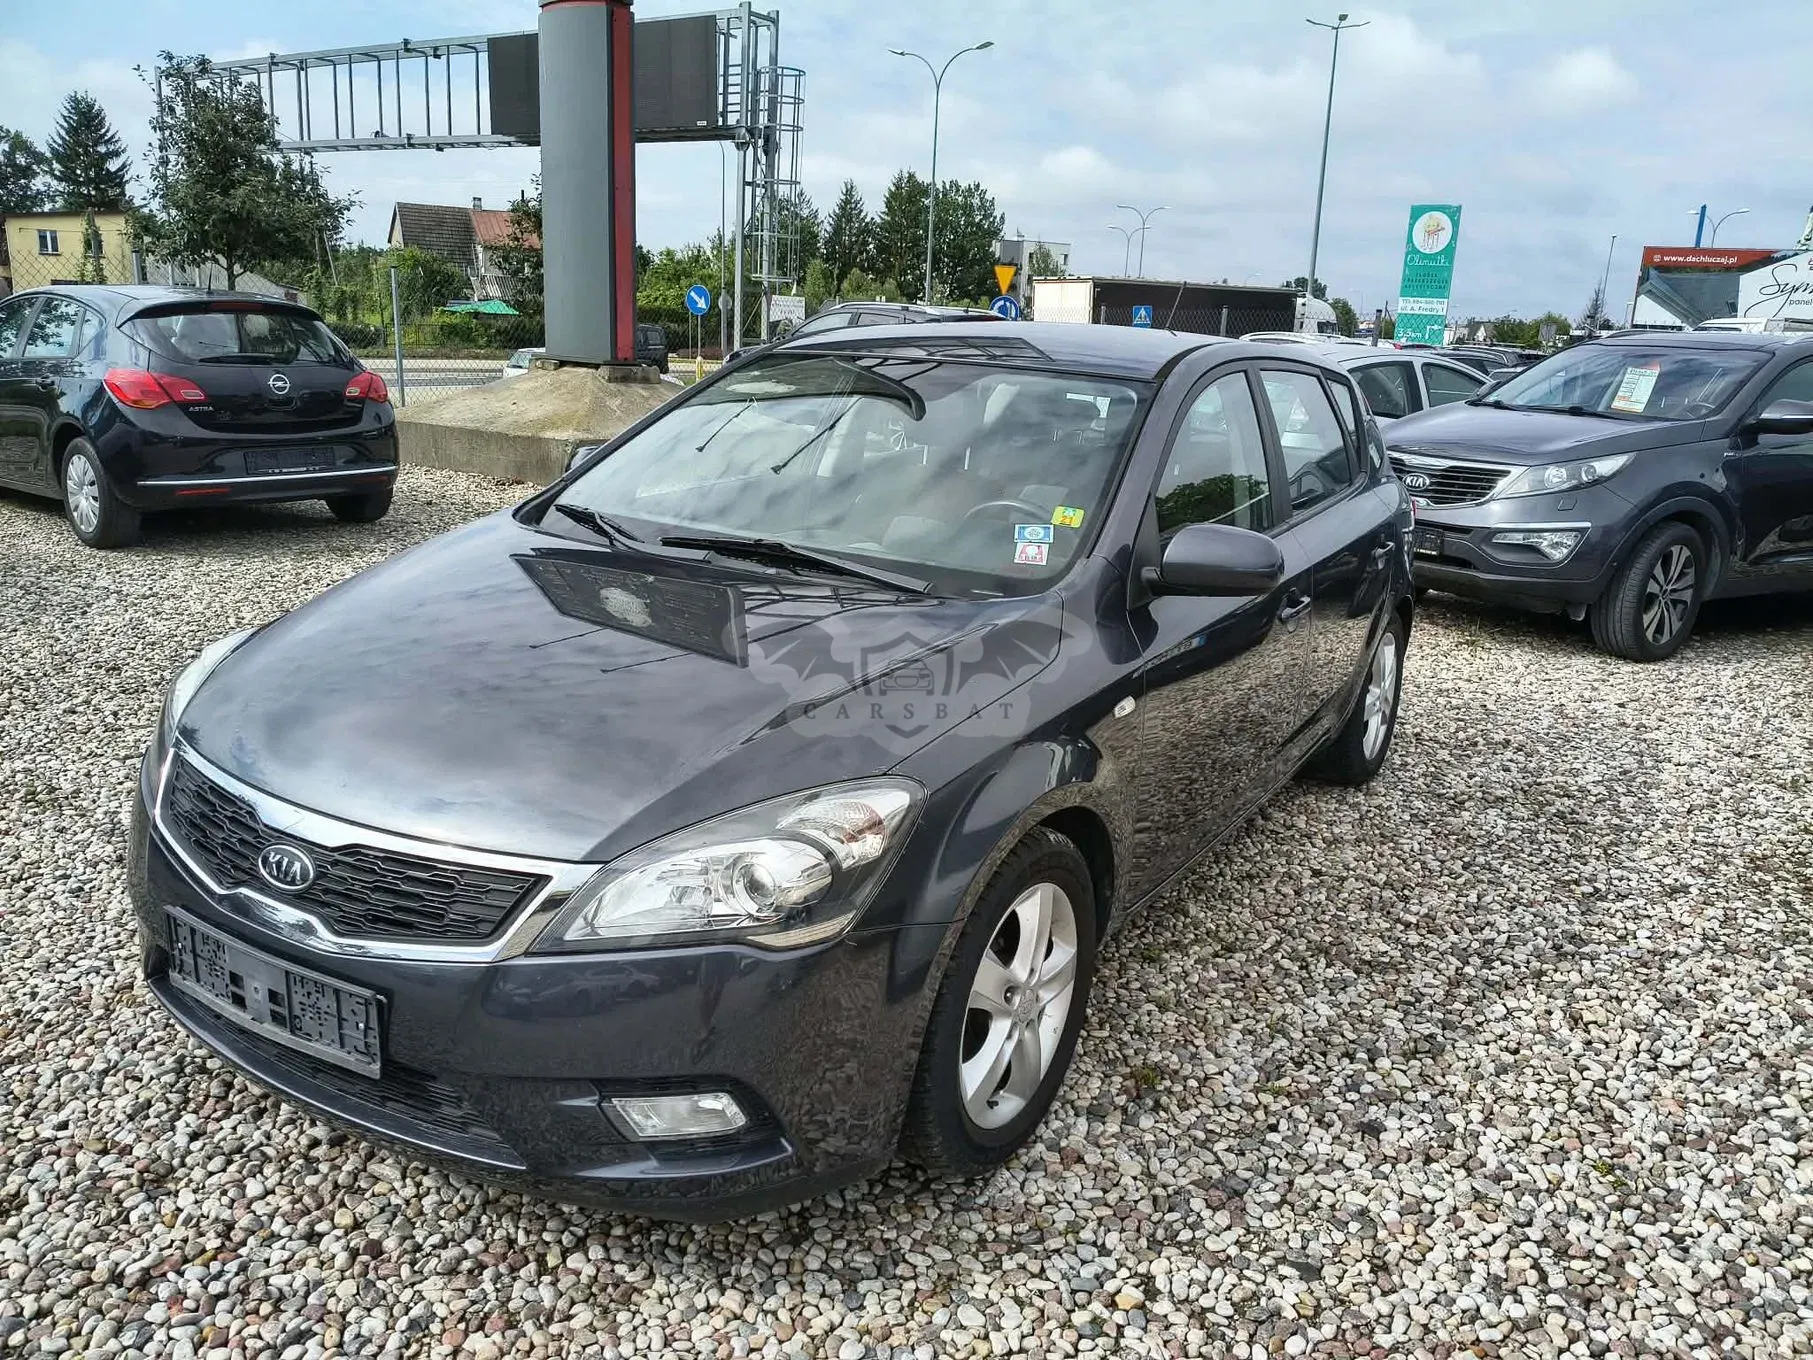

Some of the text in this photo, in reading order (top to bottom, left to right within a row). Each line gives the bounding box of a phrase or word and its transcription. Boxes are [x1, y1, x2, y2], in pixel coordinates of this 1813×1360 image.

[1663, 255, 1738, 265] www.dachluczaj.pl
[1418, 305, 1440, 314] Fredry
[1405, 475, 1424, 488] KIA
[265, 851, 303, 885] KIA
